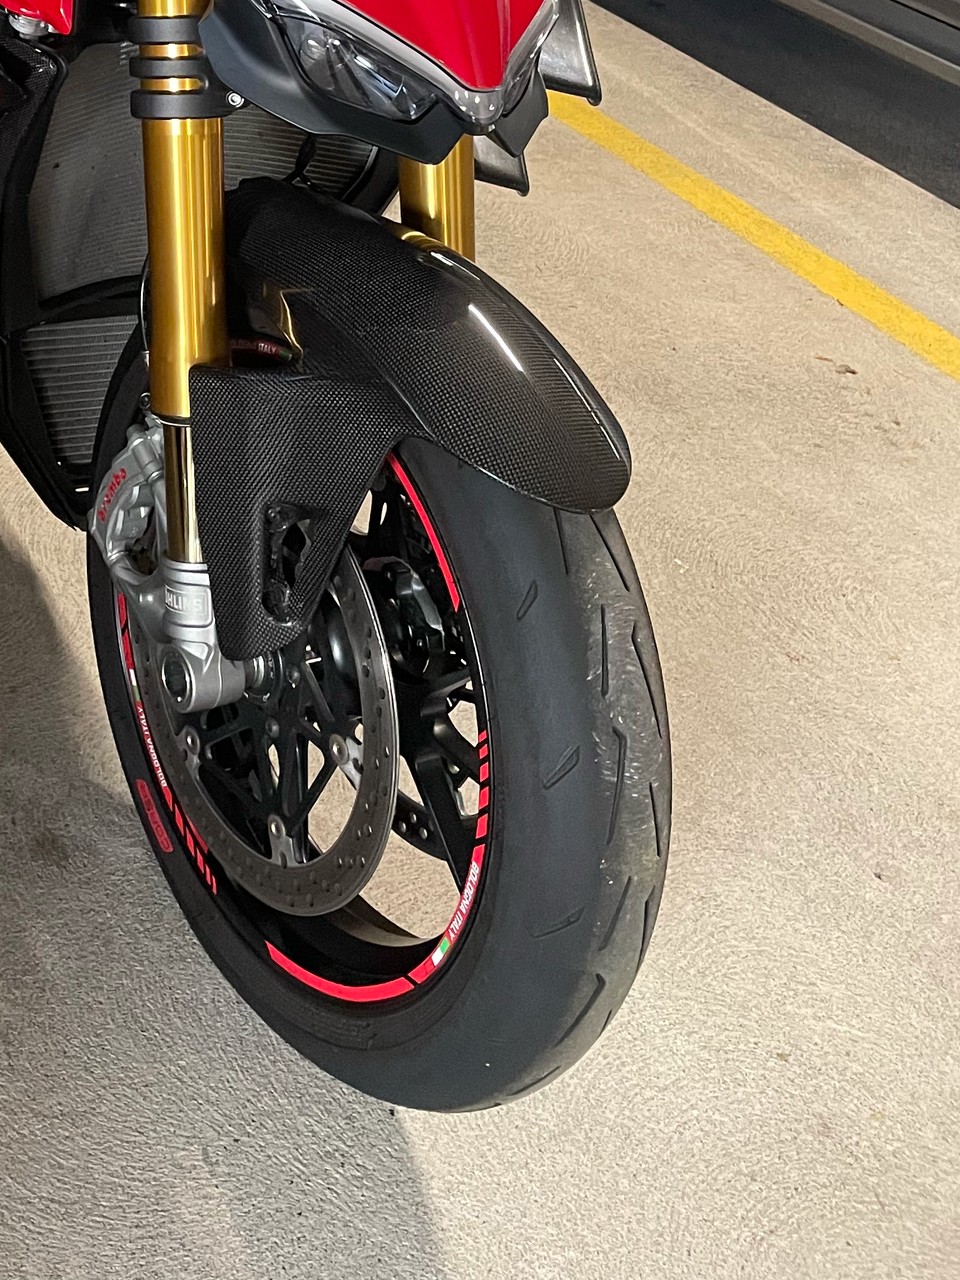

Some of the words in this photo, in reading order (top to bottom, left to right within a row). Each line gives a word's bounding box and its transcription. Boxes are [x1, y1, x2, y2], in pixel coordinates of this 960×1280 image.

[258, 343, 277, 355] ITALY
[97, 468, 127, 522] brembo
[165, 590, 202, 612] HLINS
[136, 706, 151, 735] ITALY
[145, 736, 167, 787] BOLOGNA
[459, 860, 480, 914] BOLOGNA
[449, 911, 463, 941] ITALY
